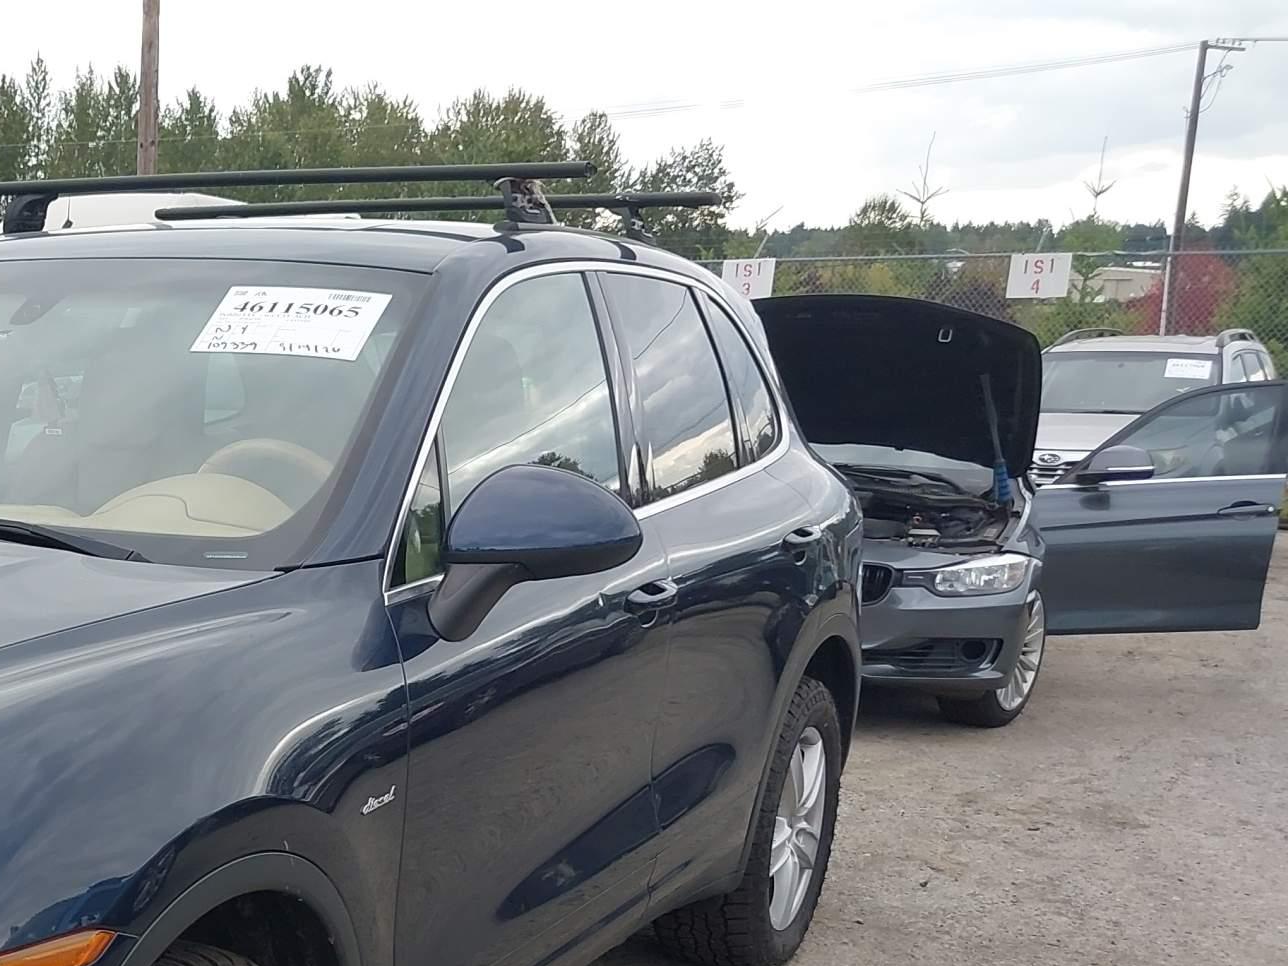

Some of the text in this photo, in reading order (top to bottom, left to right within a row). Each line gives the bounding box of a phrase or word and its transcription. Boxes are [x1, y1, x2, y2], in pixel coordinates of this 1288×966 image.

[742, 282, 751, 296] 3
[1030, 279, 1041, 295] 4
[232, 300, 364, 319] 46115065
